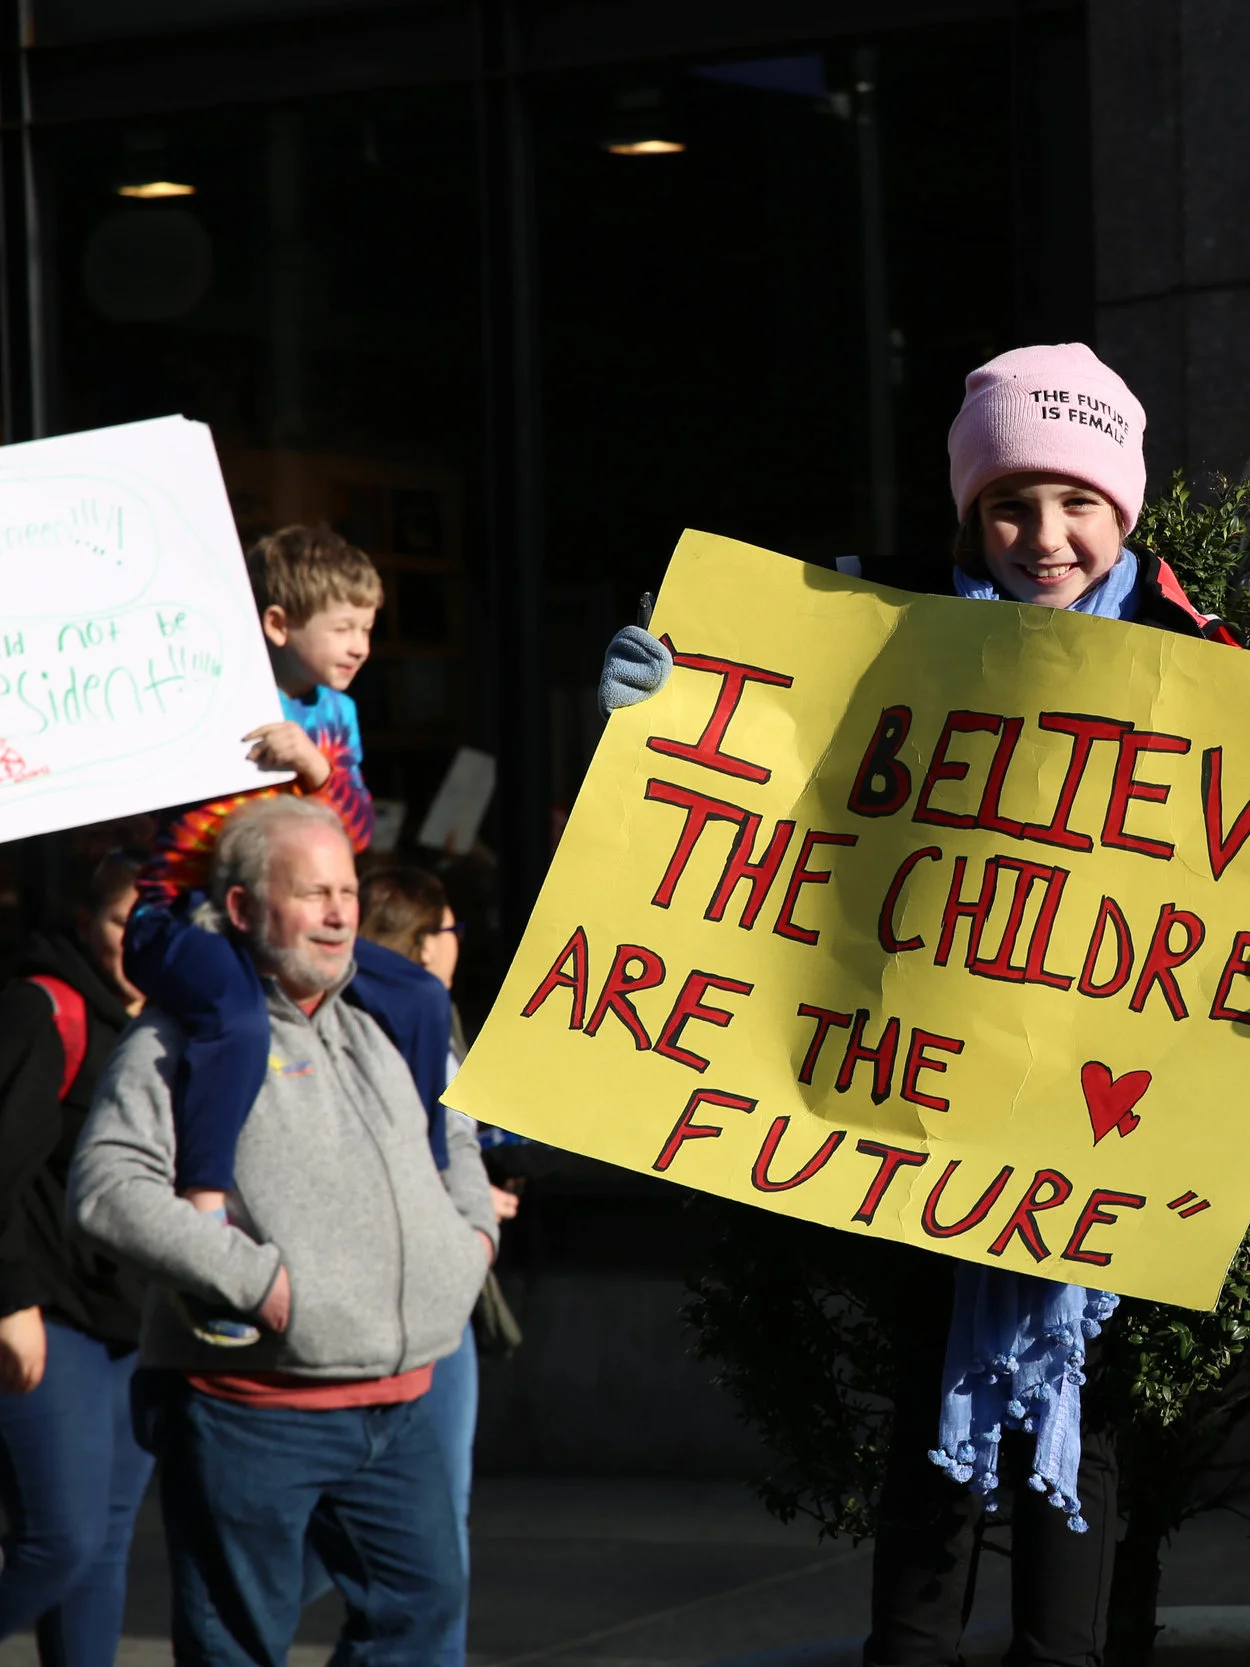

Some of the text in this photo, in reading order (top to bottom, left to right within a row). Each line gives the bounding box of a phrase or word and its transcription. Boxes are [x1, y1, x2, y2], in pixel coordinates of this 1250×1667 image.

[1029, 390, 1128, 434] THE FUTURE
[1042, 406, 1125, 448] IS FEMALE
[57, 619, 121, 654] not
[156, 610, 188, 641] be
[644, 778, 857, 946] THE
[520, 925, 965, 1112] ARE THE
